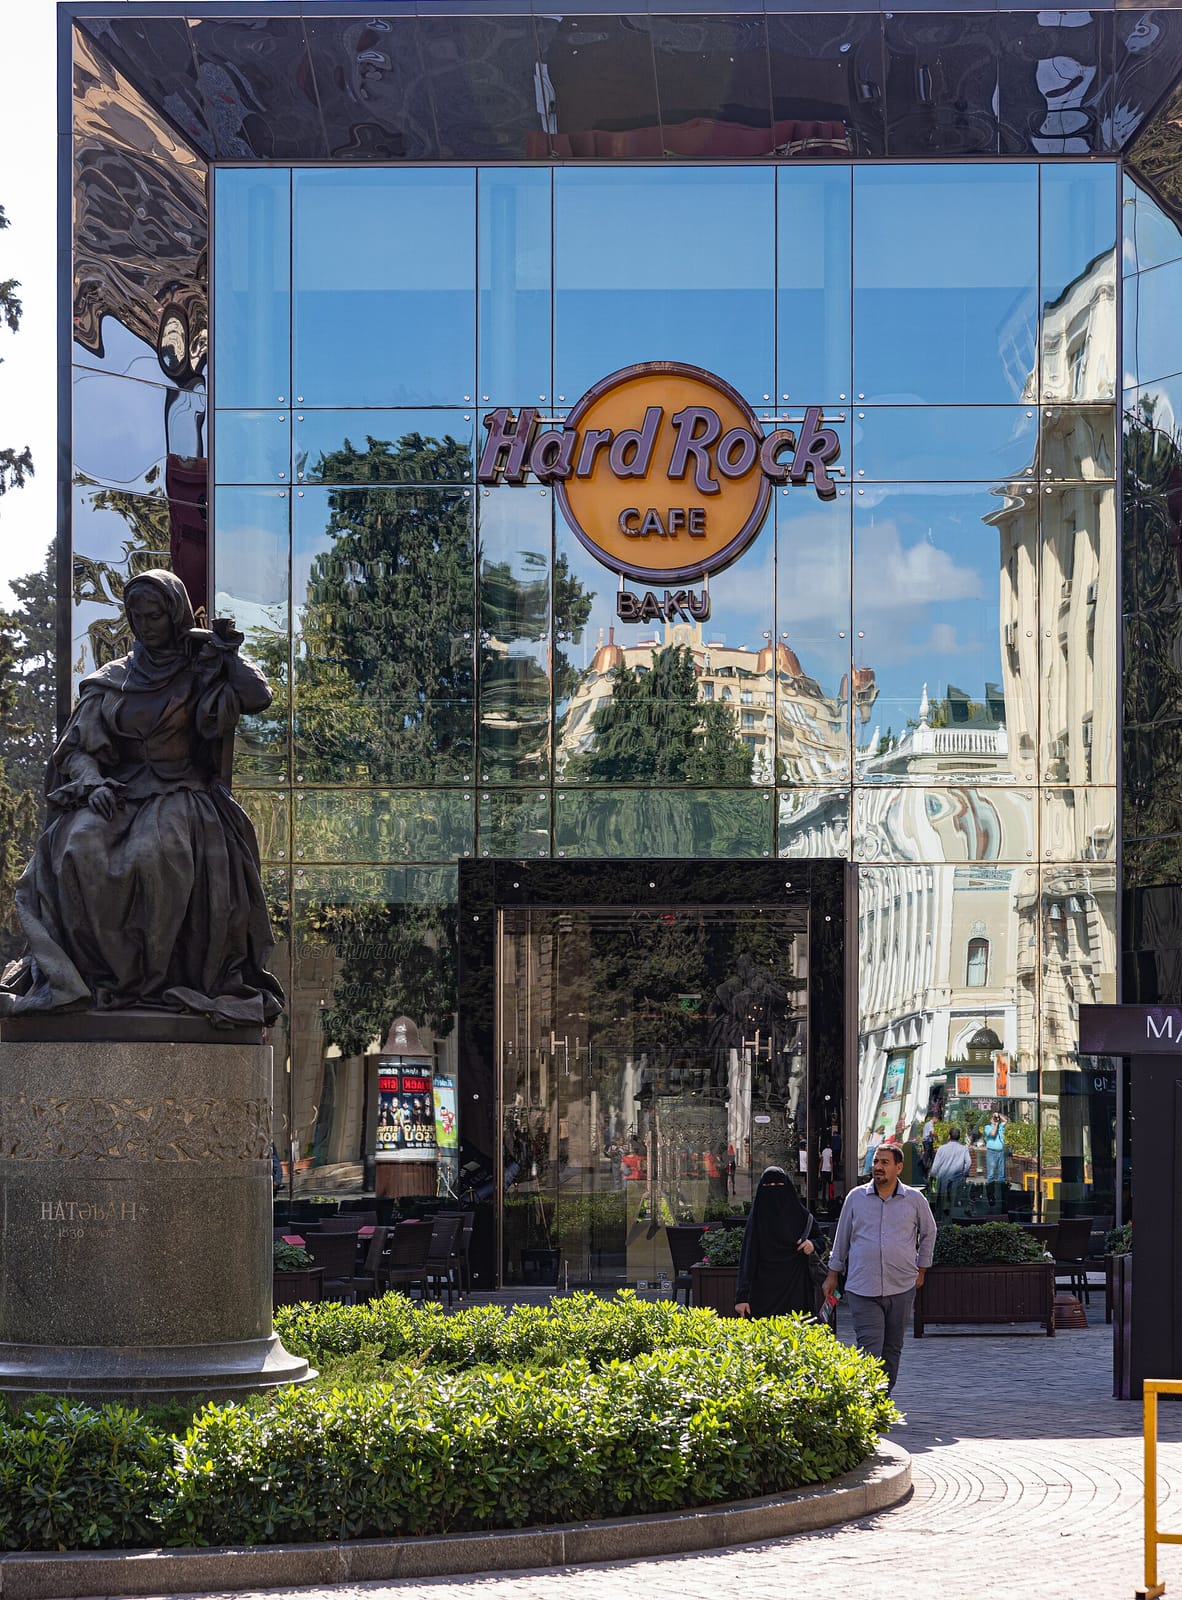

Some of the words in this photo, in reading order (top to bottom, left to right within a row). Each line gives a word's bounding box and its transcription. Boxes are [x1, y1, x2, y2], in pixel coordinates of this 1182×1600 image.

[477, 406, 664, 486] Hard
[667, 406, 842, 501] Rock
[617, 507, 708, 537] CAFE
[616, 590, 712, 624] BAKU
[1146, 1015, 1182, 1043] M
